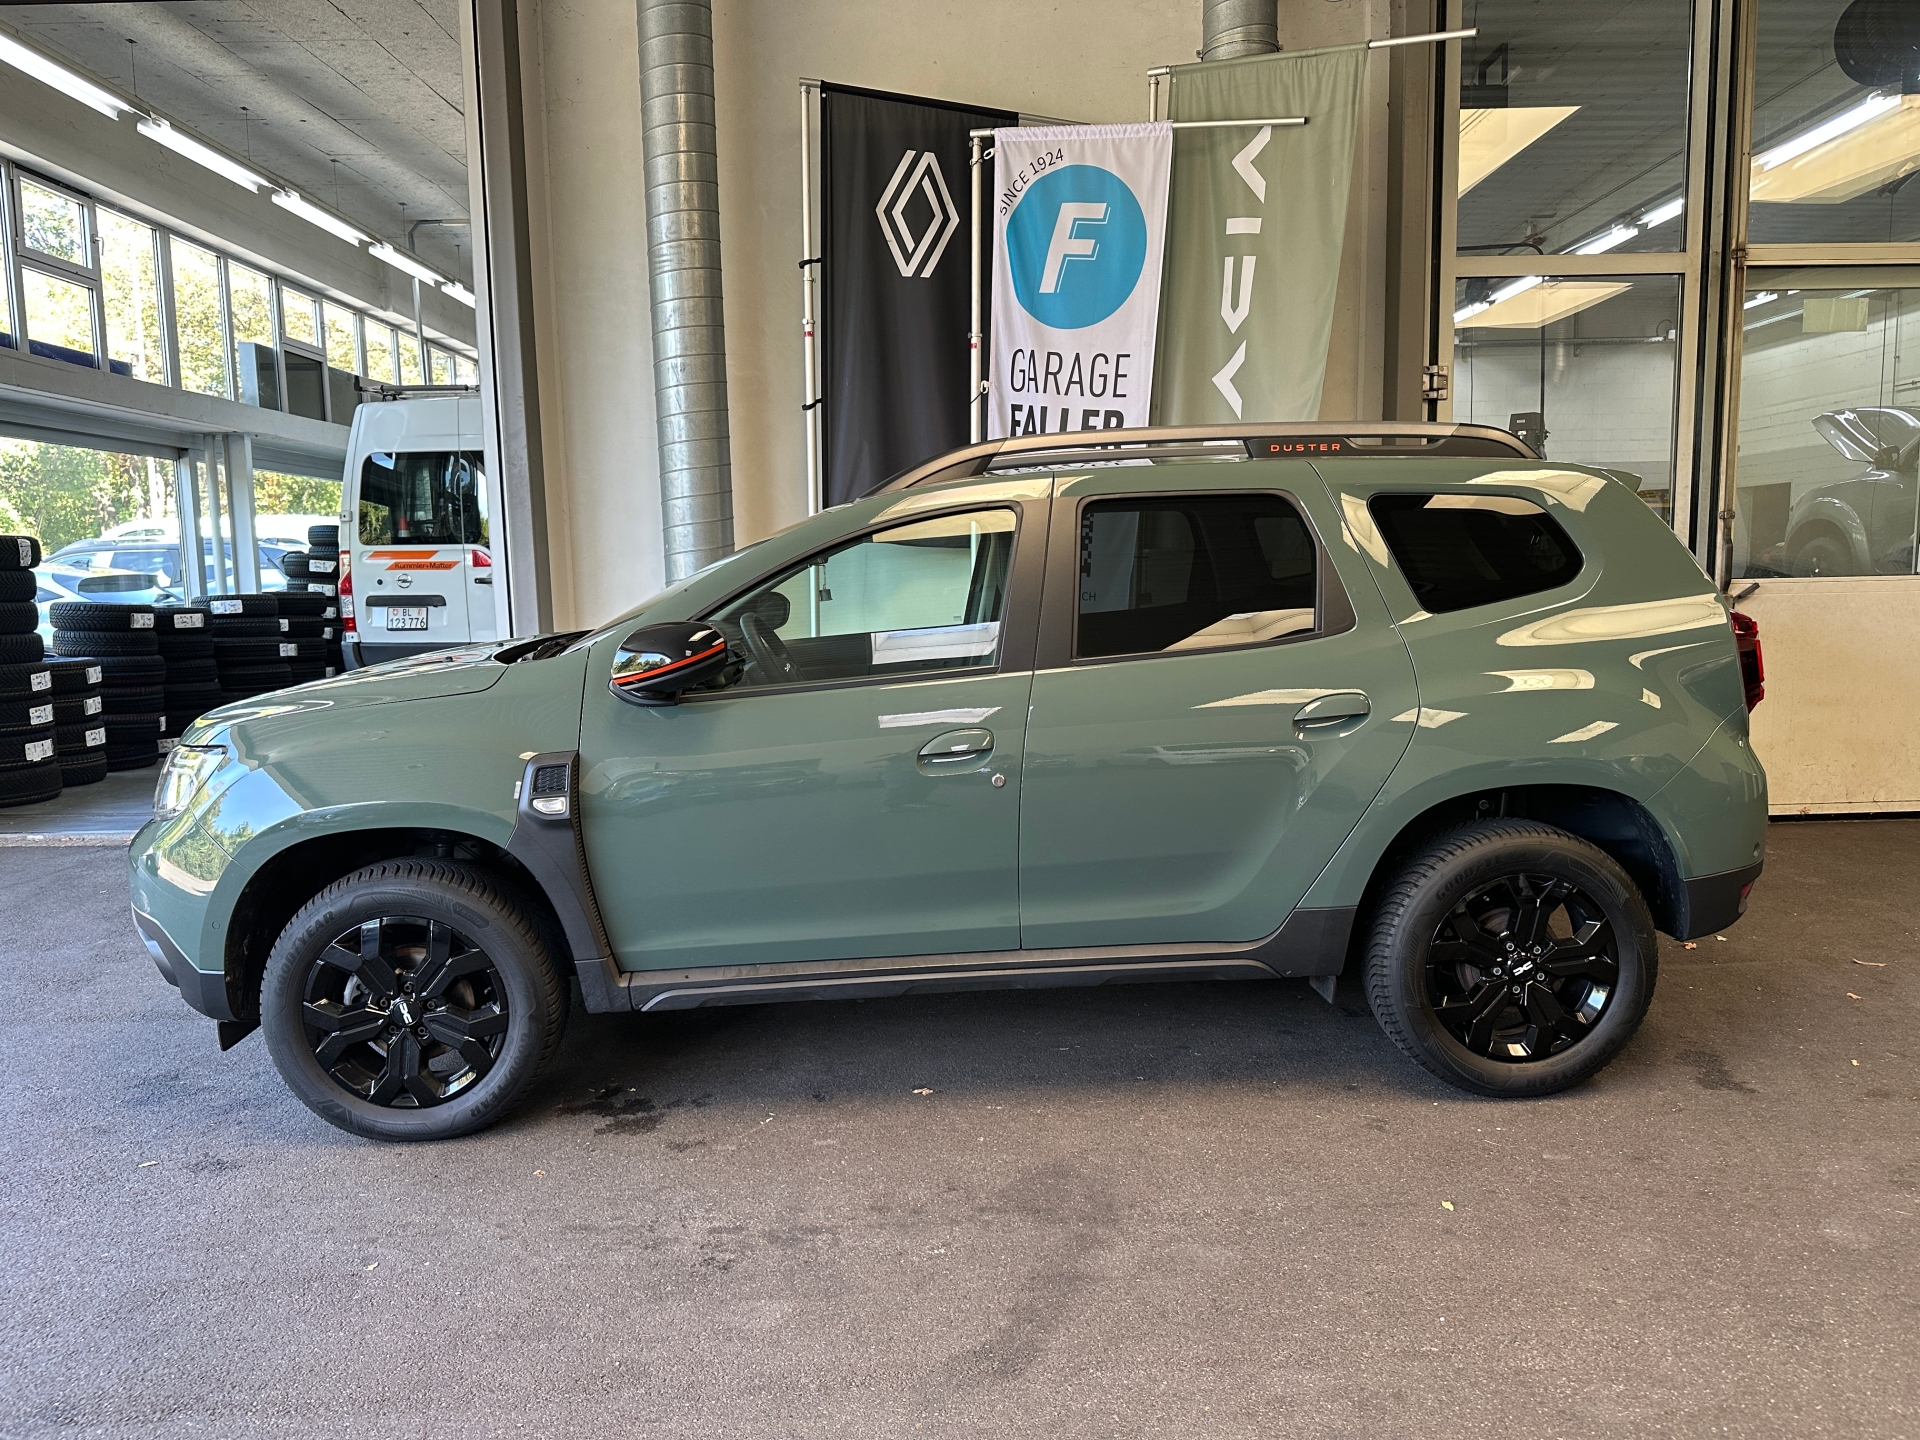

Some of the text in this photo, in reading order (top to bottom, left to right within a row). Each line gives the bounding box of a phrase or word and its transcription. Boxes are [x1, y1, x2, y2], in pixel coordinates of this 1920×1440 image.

[1000, 148, 1064, 216] SINCE 1924
[1038, 202, 1111, 294] F
[1010, 348, 1131, 398] GARAGE
[1270, 443, 1341, 452] DUSTER
[402, 609, 412, 617] BL
[408, 617, 425, 628] 776
